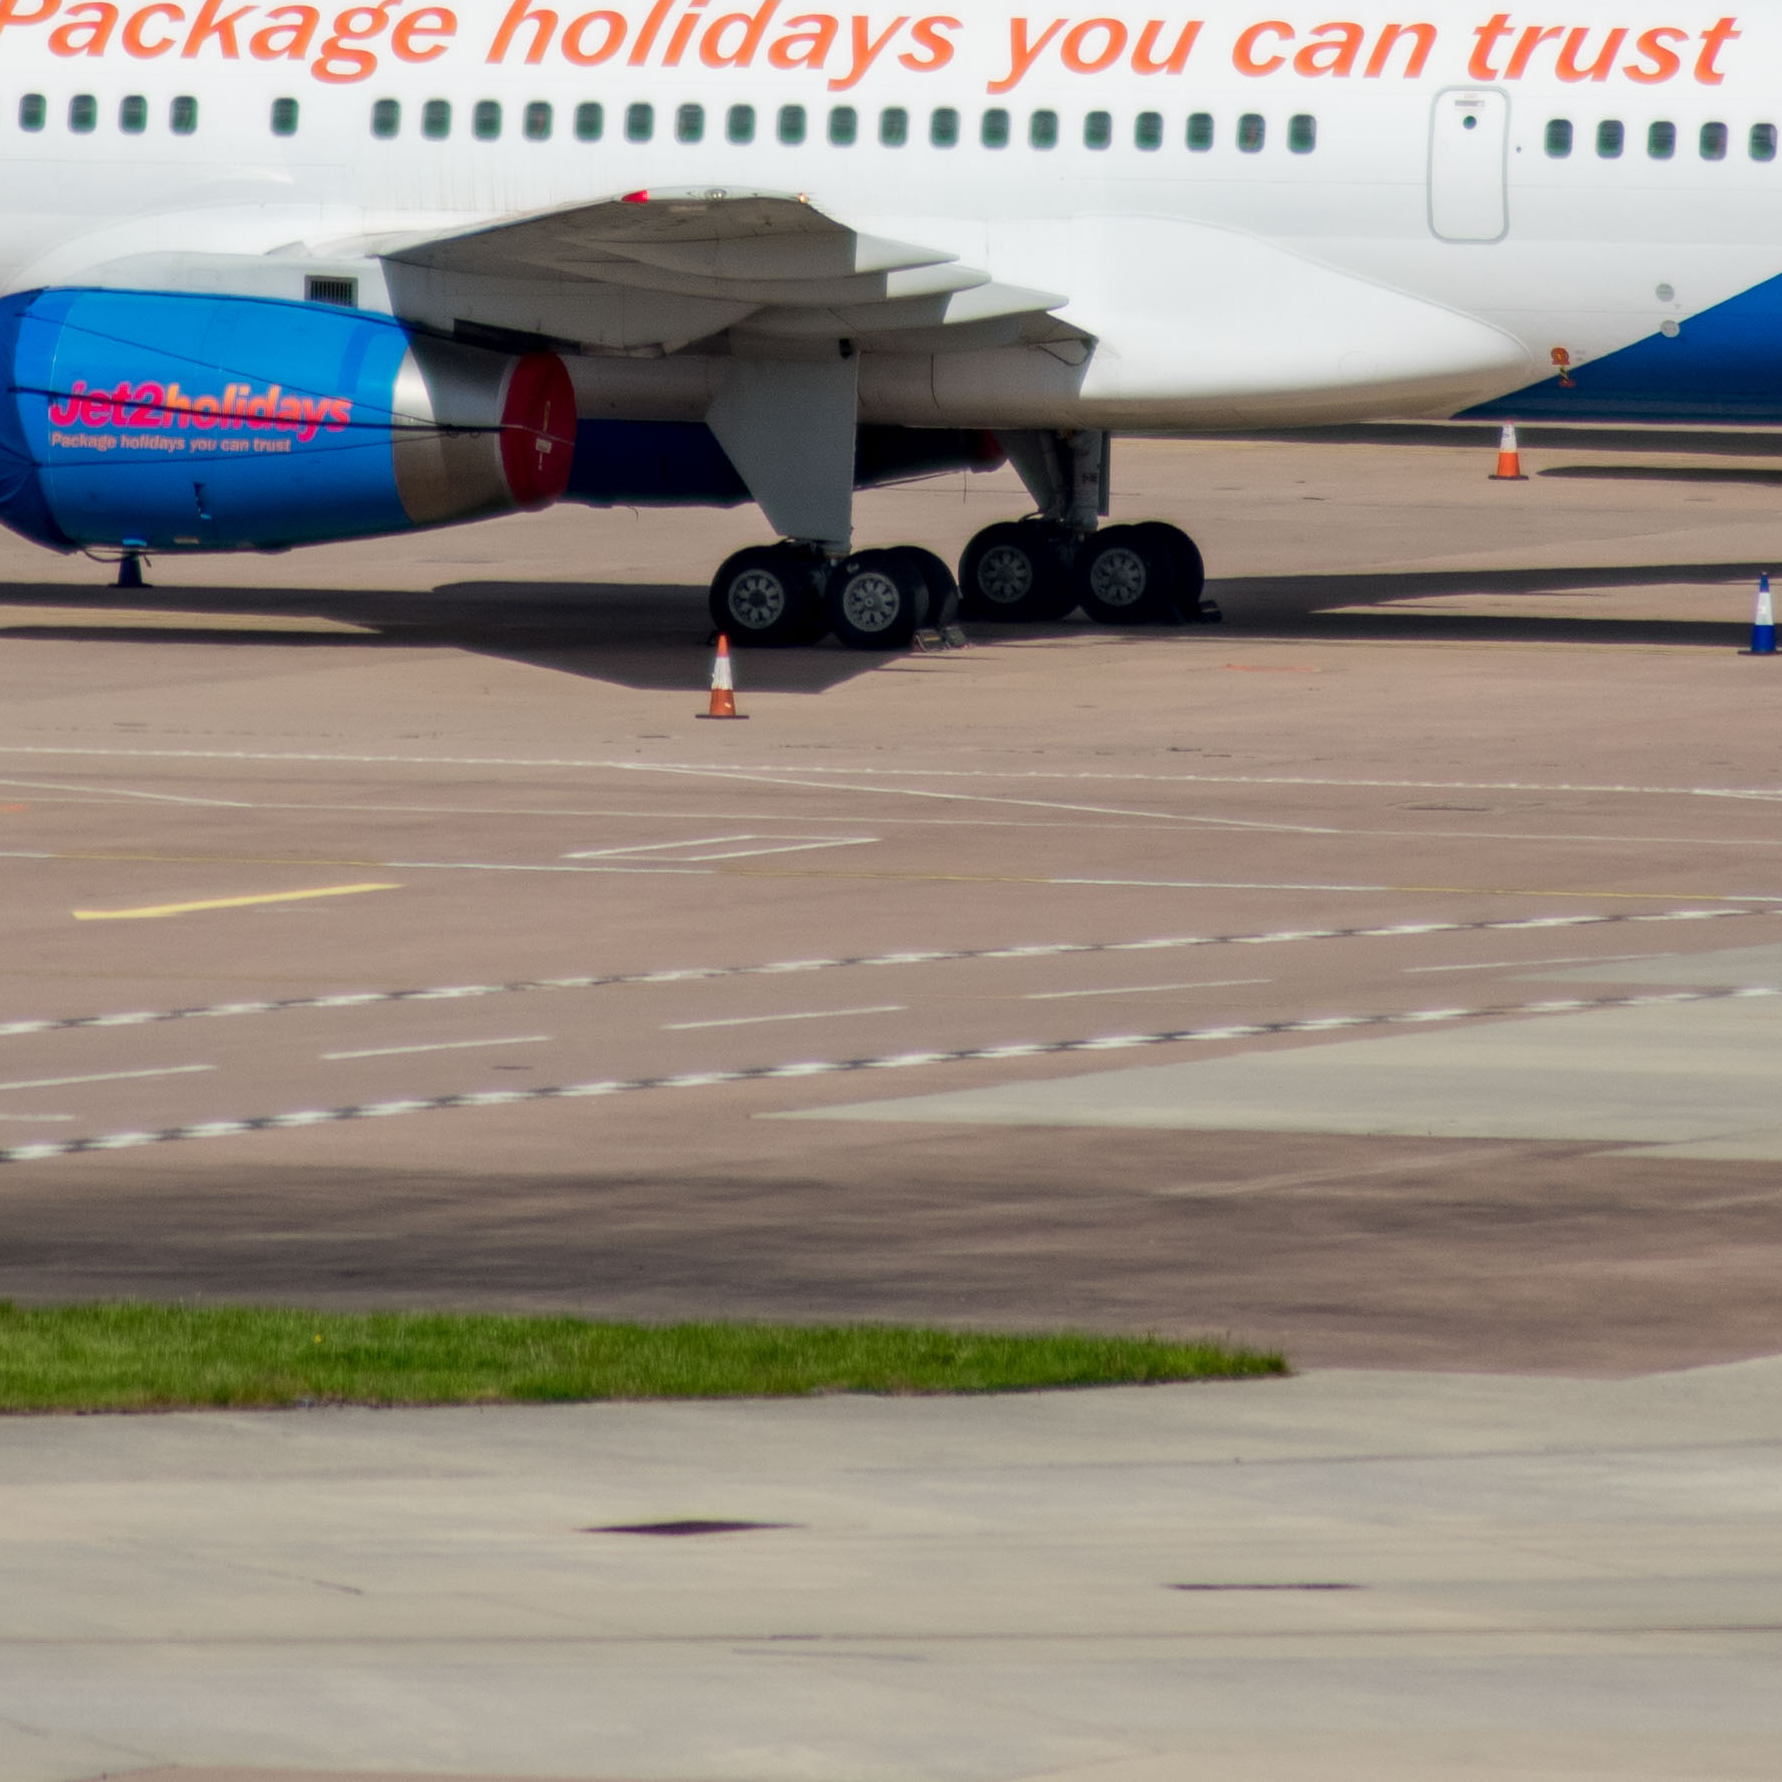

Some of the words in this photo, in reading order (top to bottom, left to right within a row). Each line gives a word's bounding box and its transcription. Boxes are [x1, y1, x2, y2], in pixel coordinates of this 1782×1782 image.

[986, 16, 1206, 96] you
[1230, 18, 1442, 79] can
[1465, 12, 1742, 87] trust
[48, 380, 354, 443] Jet2holidays
[51, 430, 117, 452] Package
[120, 433, 186, 453] holidays
[189, 437, 218, 454] you
[220, 437, 250, 452] can
[253, 436, 292, 453] trust
